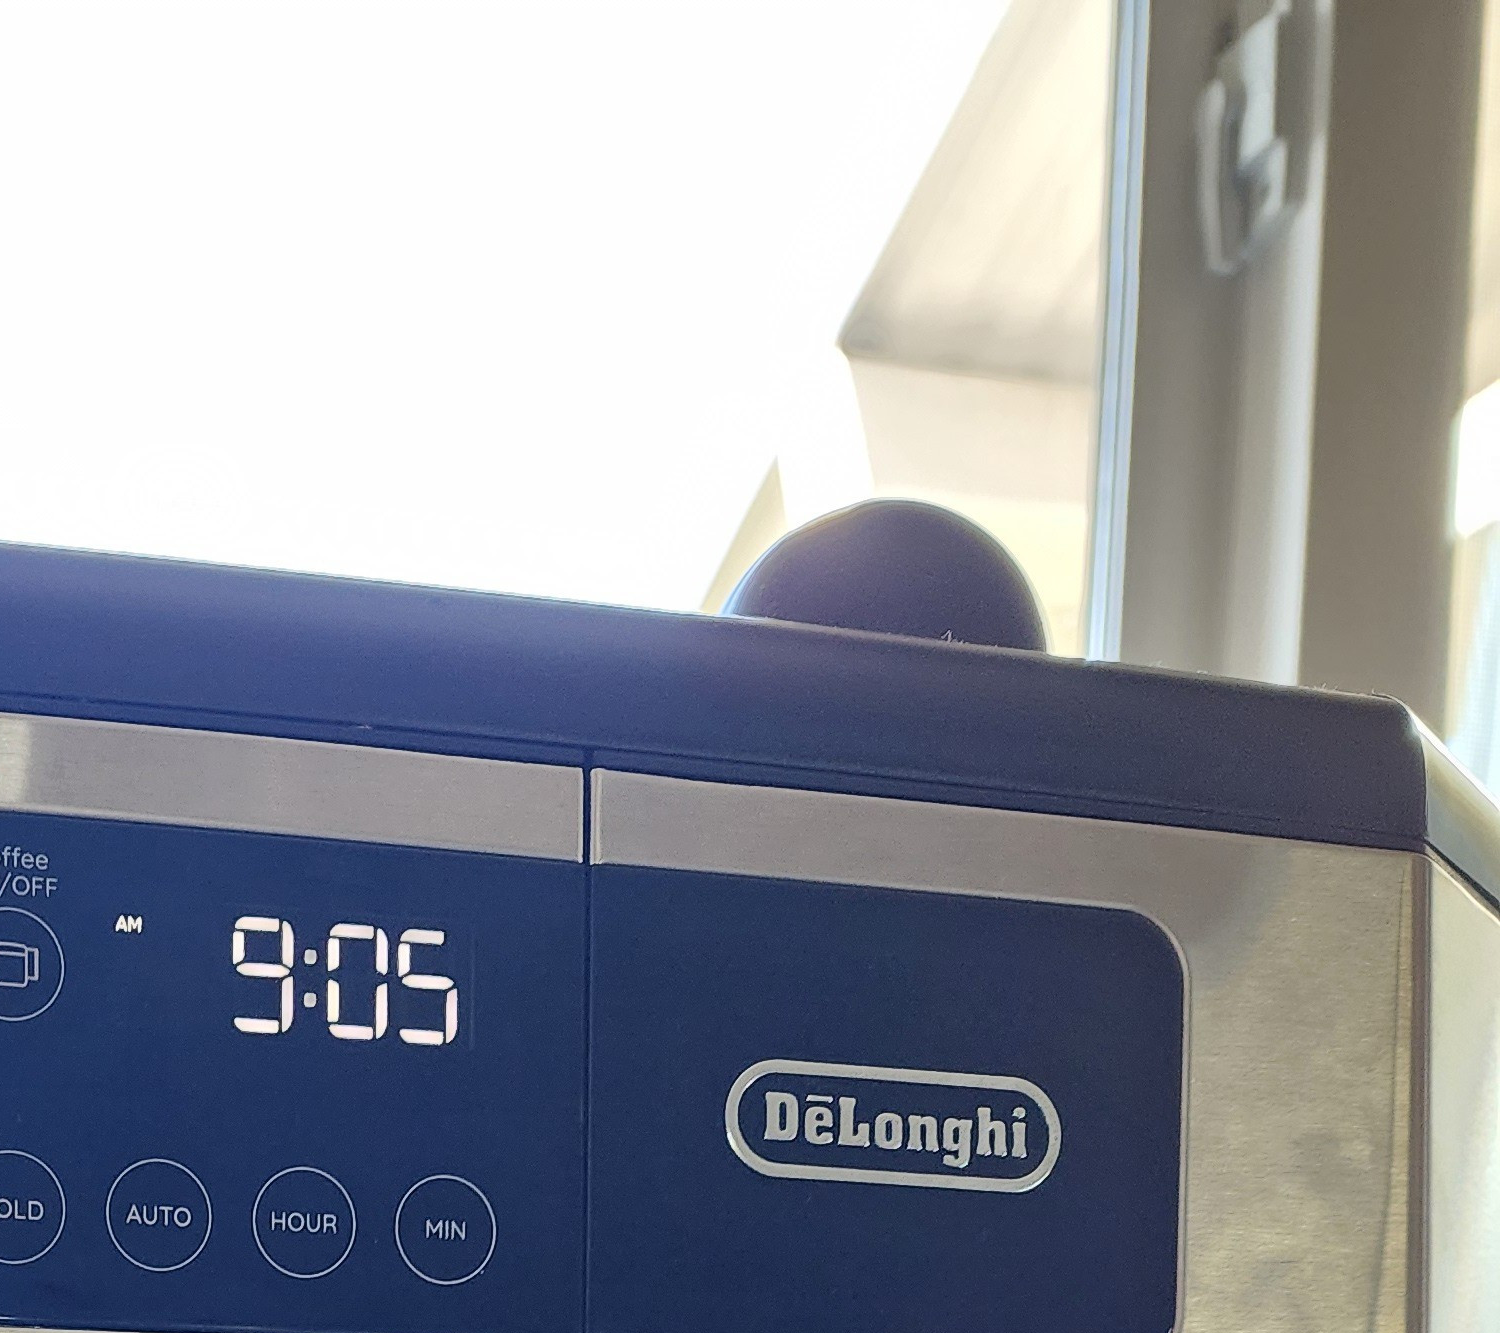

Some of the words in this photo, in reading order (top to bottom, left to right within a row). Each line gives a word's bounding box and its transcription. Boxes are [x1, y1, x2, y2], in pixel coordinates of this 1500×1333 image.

[114, 914, 144, 934] AM
[231, 915, 459, 1047] 9:05
[125, 1203, 193, 1228] AUTO
[270, 1210, 338, 1235] HOUR
[424, 1218, 467, 1241] MIN
